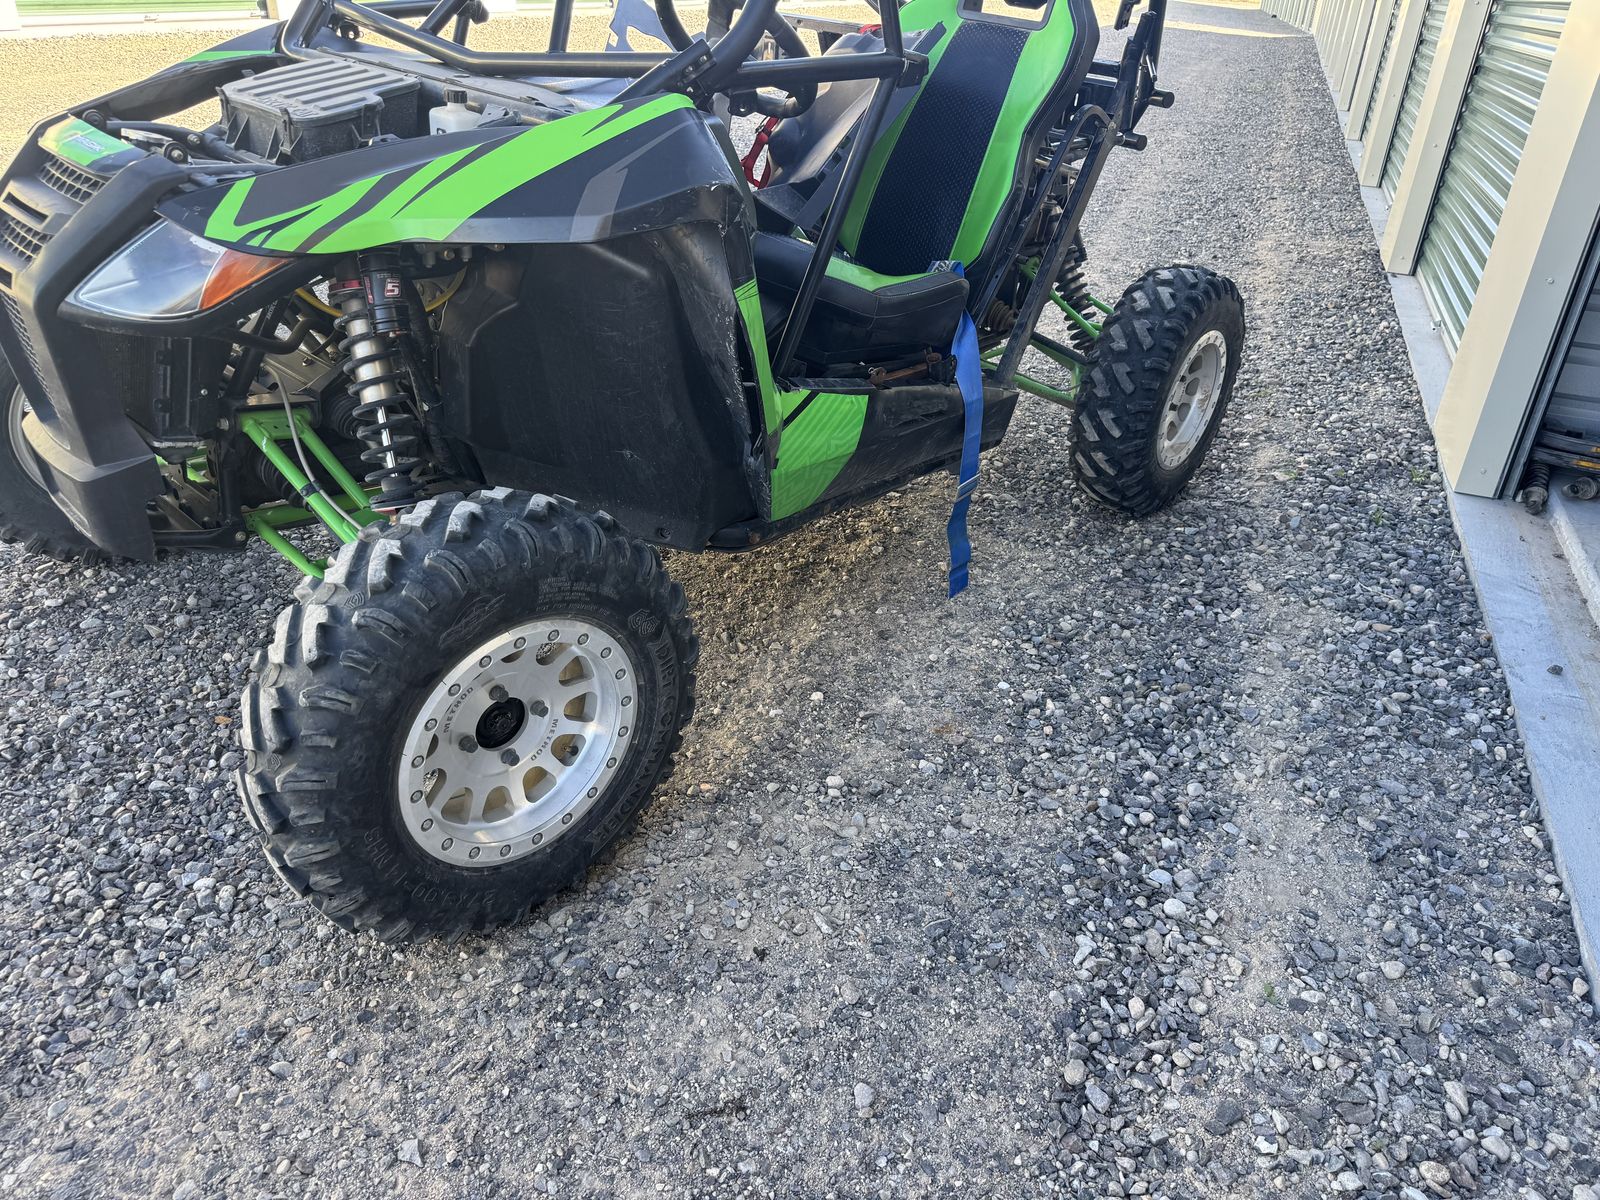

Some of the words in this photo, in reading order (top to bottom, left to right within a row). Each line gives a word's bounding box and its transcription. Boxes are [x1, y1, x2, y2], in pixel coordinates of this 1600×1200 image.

[386, 283, 399, 295] 5
[654, 642, 676, 688] DIRT
[443, 686, 474, 734] METHOD
[530, 718, 559, 761] METHOD
